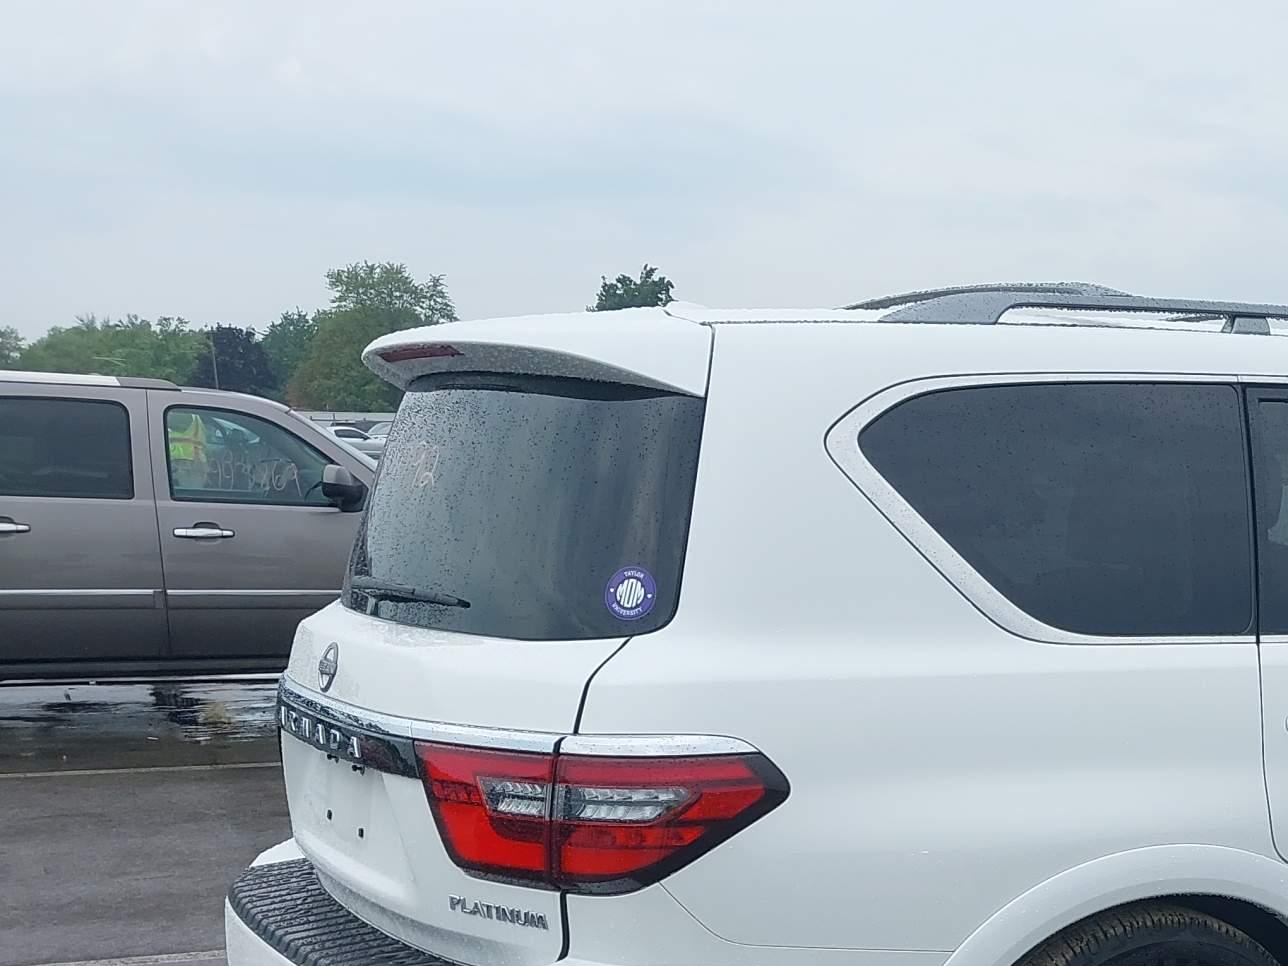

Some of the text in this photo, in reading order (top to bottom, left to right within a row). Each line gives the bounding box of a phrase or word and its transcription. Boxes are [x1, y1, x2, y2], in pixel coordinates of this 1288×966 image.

[623, 570, 644, 579] TAYLOR
[615, 578, 645, 608] MOM
[448, 894, 549, 930] PLATINUM
